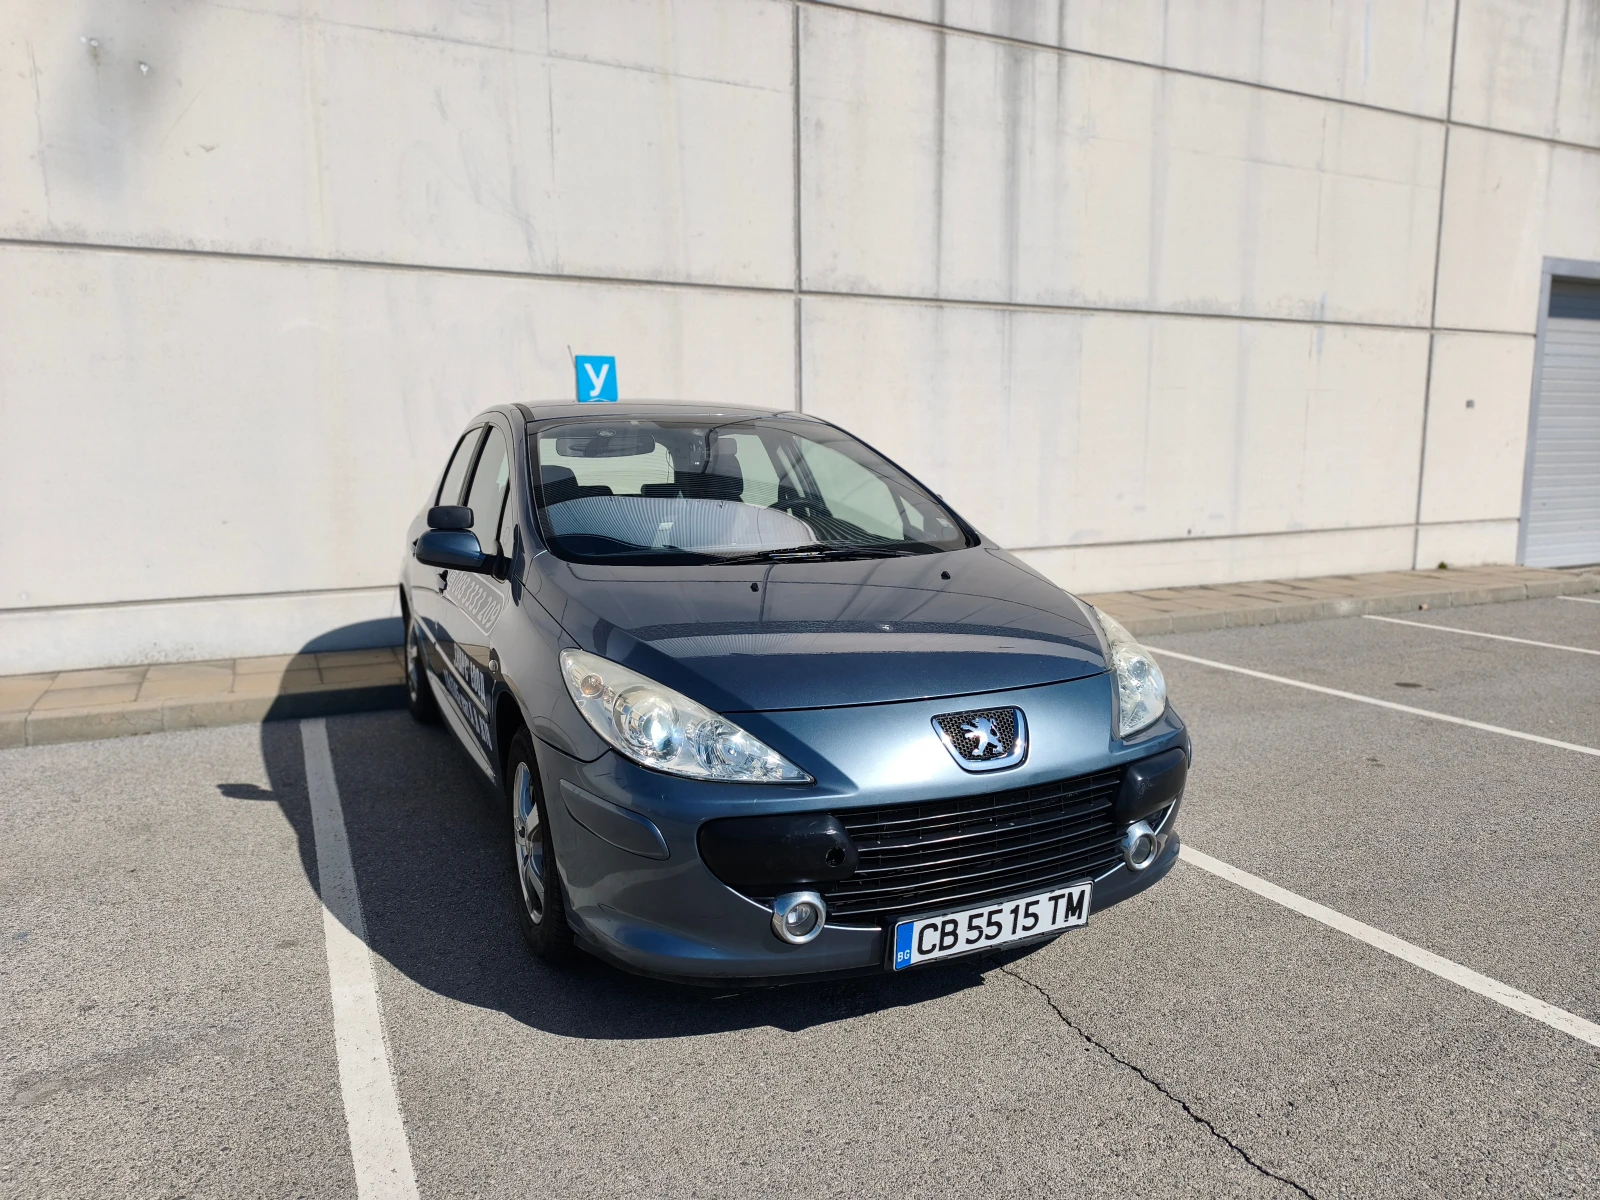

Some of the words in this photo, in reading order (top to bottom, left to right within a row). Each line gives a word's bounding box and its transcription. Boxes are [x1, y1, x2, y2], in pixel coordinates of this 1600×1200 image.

[451, 572, 471, 600] 088
[462, 581, 487, 615] 3333
[477, 596, 501, 629] 209
[917, 918, 959, 956] CB
[965, 899, 1041, 945] 5515
[1048, 889, 1086, 926] TM
[897, 950, 910, 962] BG
